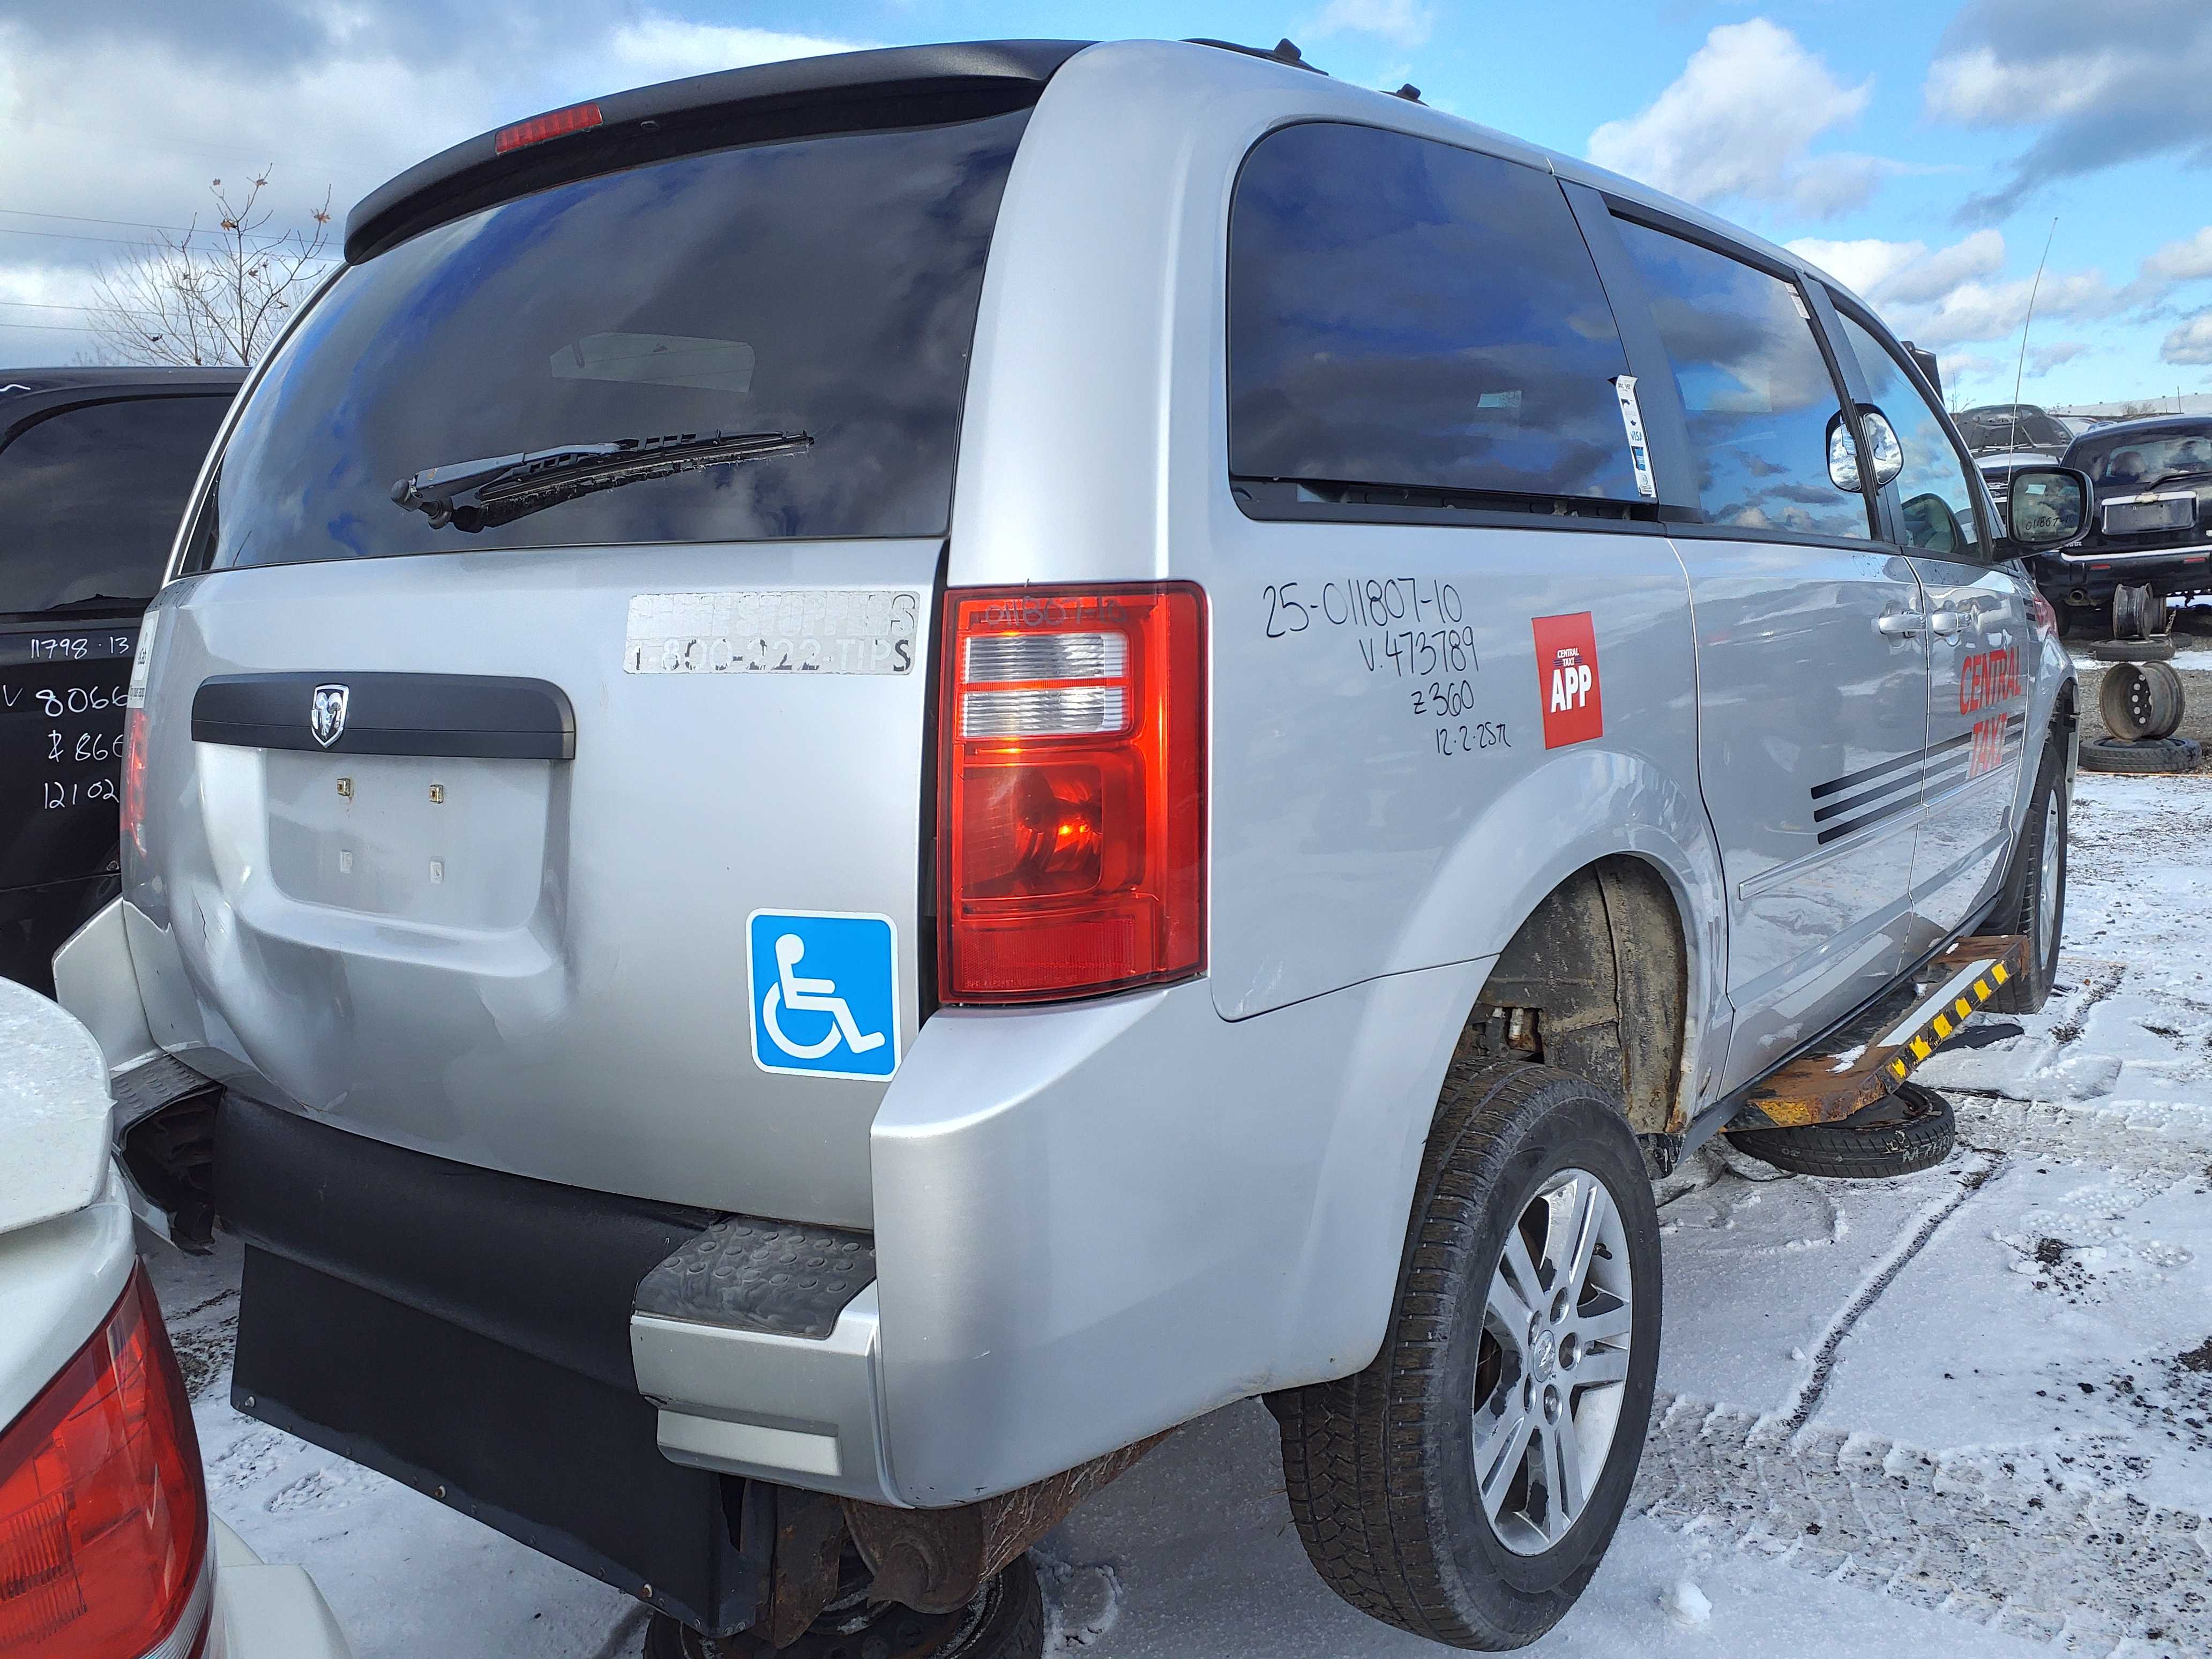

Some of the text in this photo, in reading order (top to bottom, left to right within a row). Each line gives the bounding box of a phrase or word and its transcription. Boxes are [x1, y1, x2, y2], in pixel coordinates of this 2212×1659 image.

[1263, 577, 1462, 638] 25-011807-10
[1557, 647, 1580, 659] CENTRAL
[1562, 657, 1575, 667] TAXI
[1959, 645, 2022, 716] CENTRAL
[1550, 664, 1593, 714] APP
[1968, 712, 2008, 780] TAXI
